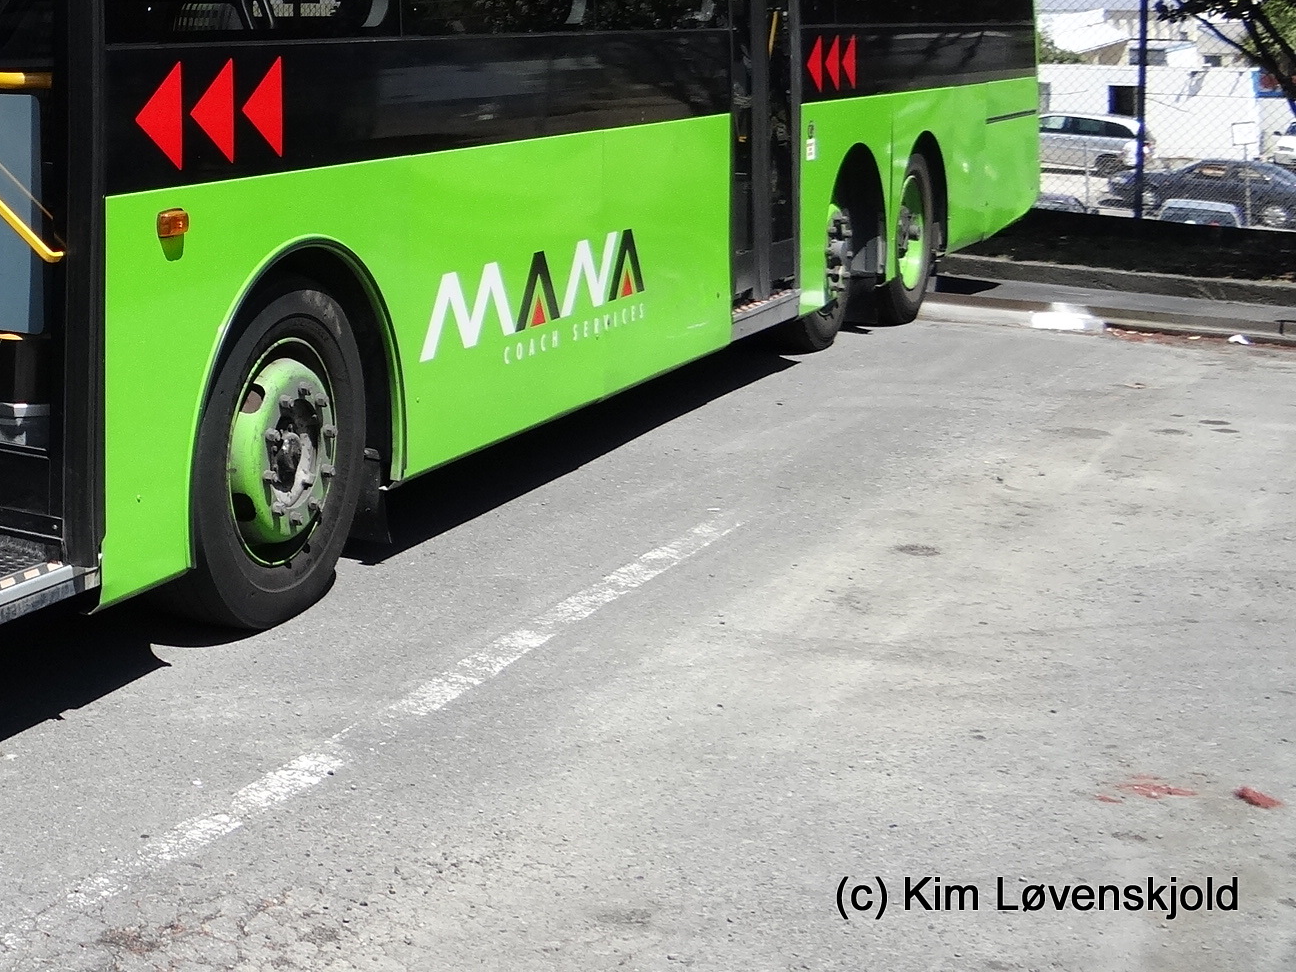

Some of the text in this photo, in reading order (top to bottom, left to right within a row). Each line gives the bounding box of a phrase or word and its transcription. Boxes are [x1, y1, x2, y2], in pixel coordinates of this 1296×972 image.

[419, 228, 646, 364] MANA
[504, 302, 645, 365] COACH SERVICES
